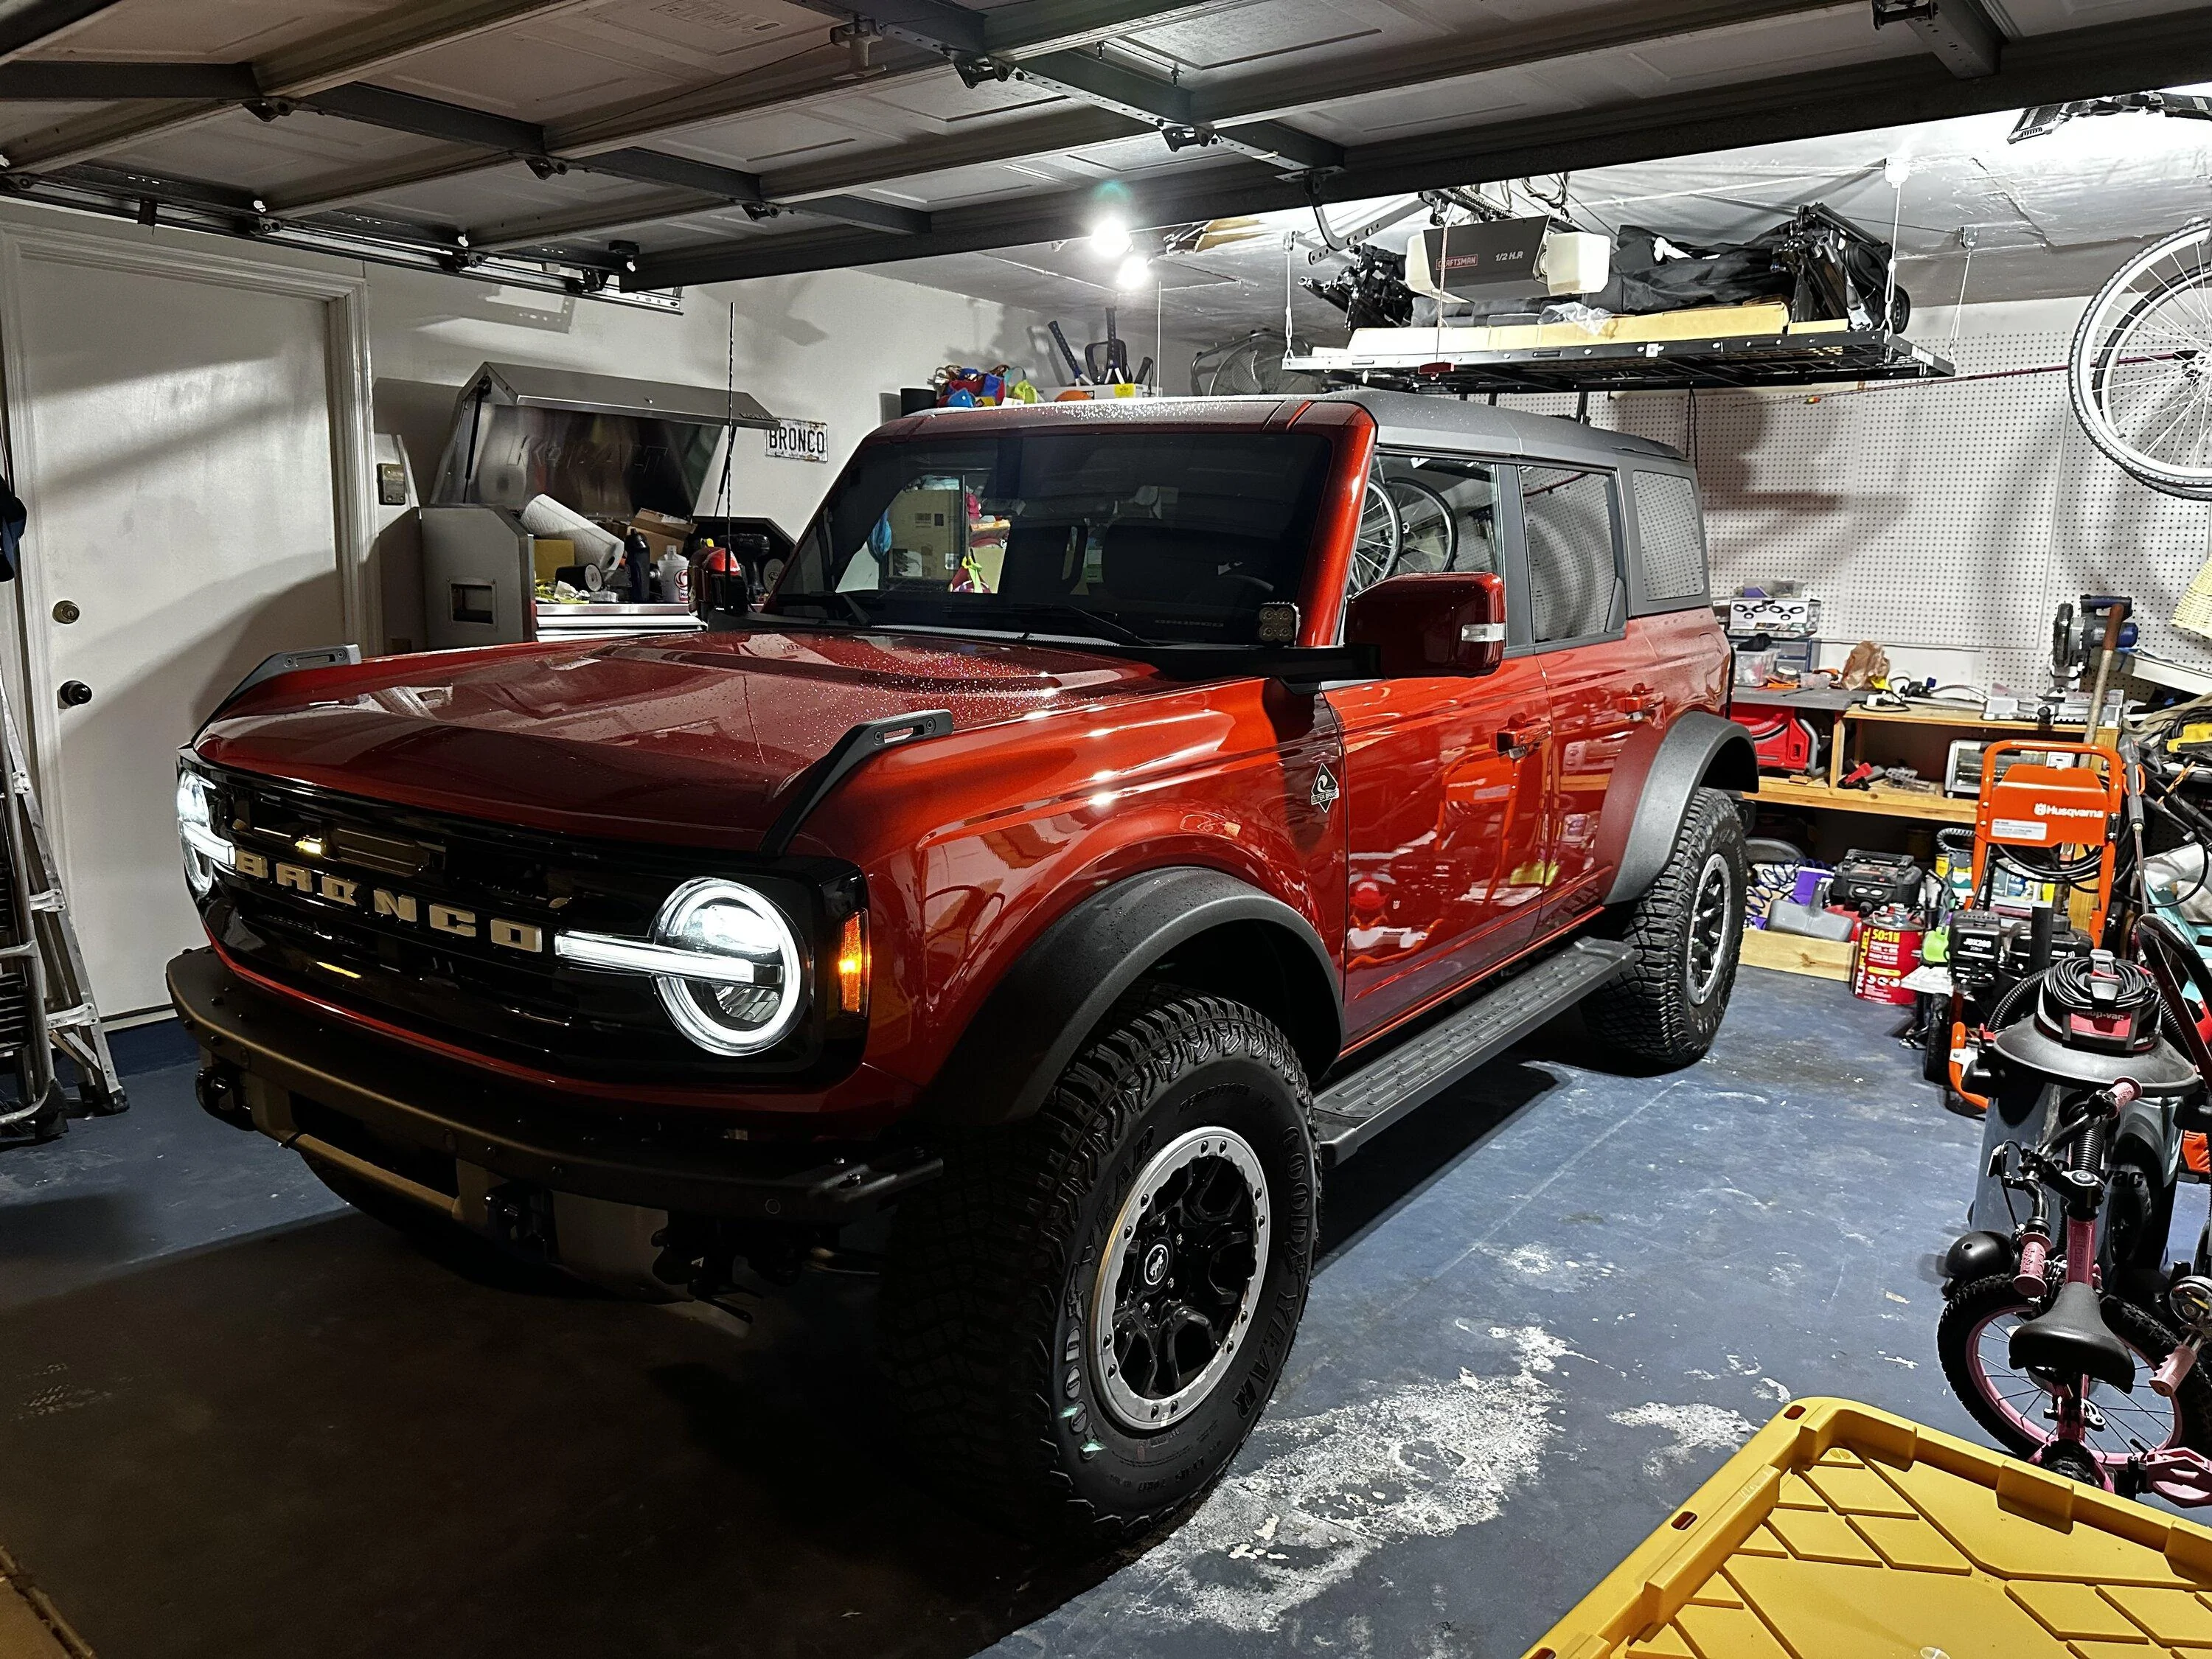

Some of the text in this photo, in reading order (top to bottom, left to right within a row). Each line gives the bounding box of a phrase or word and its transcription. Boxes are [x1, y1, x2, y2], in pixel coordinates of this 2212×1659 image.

[1438, 256, 1476, 268] CAFTSMAN
[1495, 253, 1508, 262] 1/2
[769, 426, 824, 453] BRONCO
[2046, 805, 2104, 818] Husqvarna
[236, 849, 543, 953] BRONCO
[1871, 929, 1893, 942] 50:1
[1855, 928, 1871, 995] TRUFUEL
